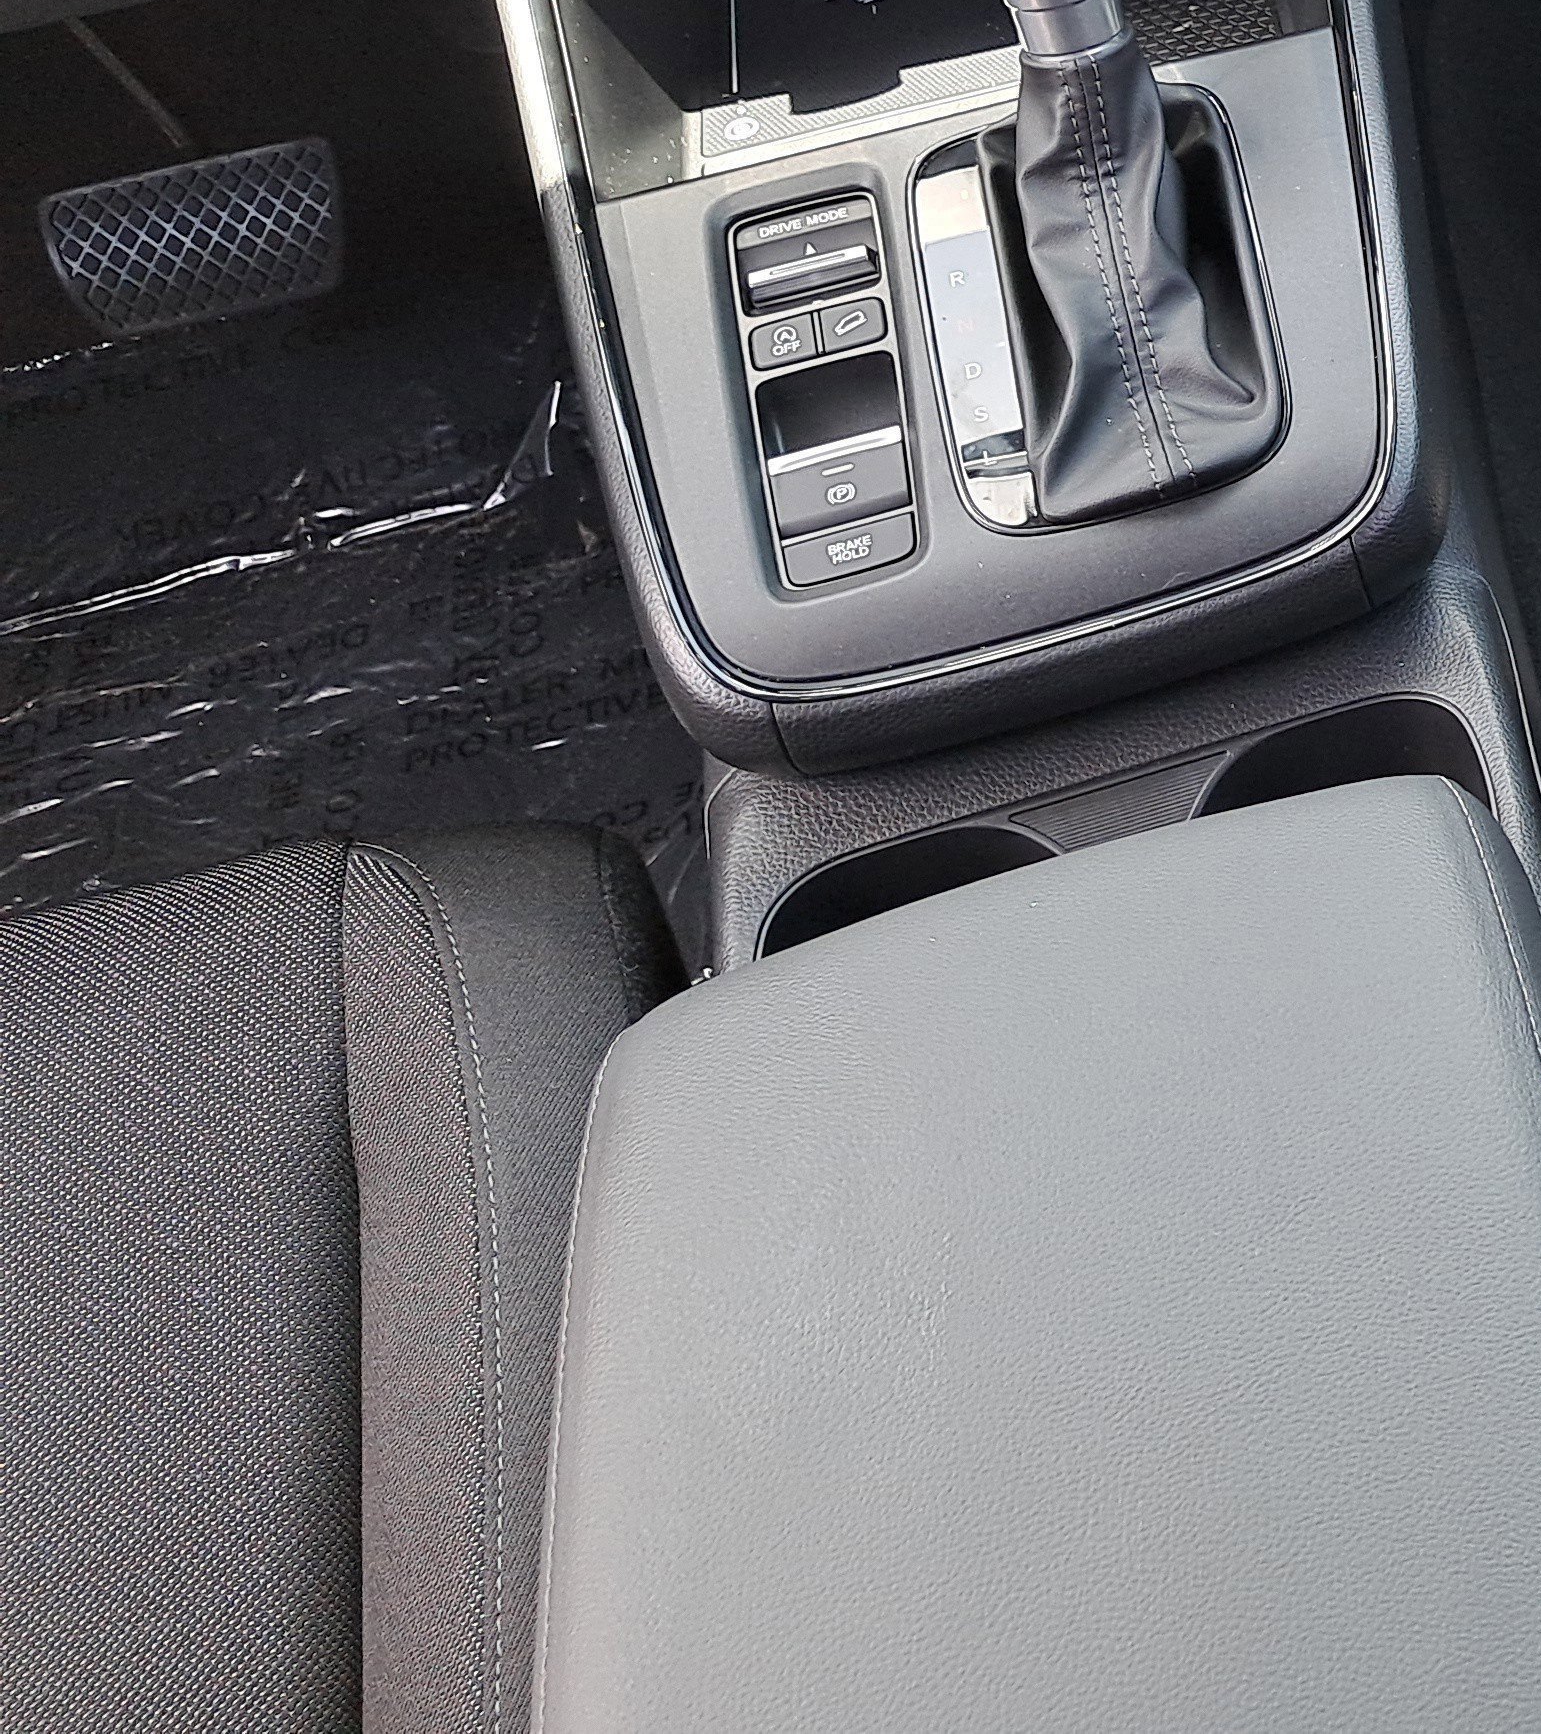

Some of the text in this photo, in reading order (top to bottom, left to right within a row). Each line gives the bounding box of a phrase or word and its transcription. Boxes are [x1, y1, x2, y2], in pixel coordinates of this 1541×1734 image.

[759, 207, 849, 239] DRIVE MODE
[949, 270, 966, 287] R
[772, 339, 801, 356] OFF
[964, 362, 983, 381] D
[973, 405, 990, 423] S
[827, 534, 872, 556] BRAKE
[832, 546, 870, 565] HOLD
